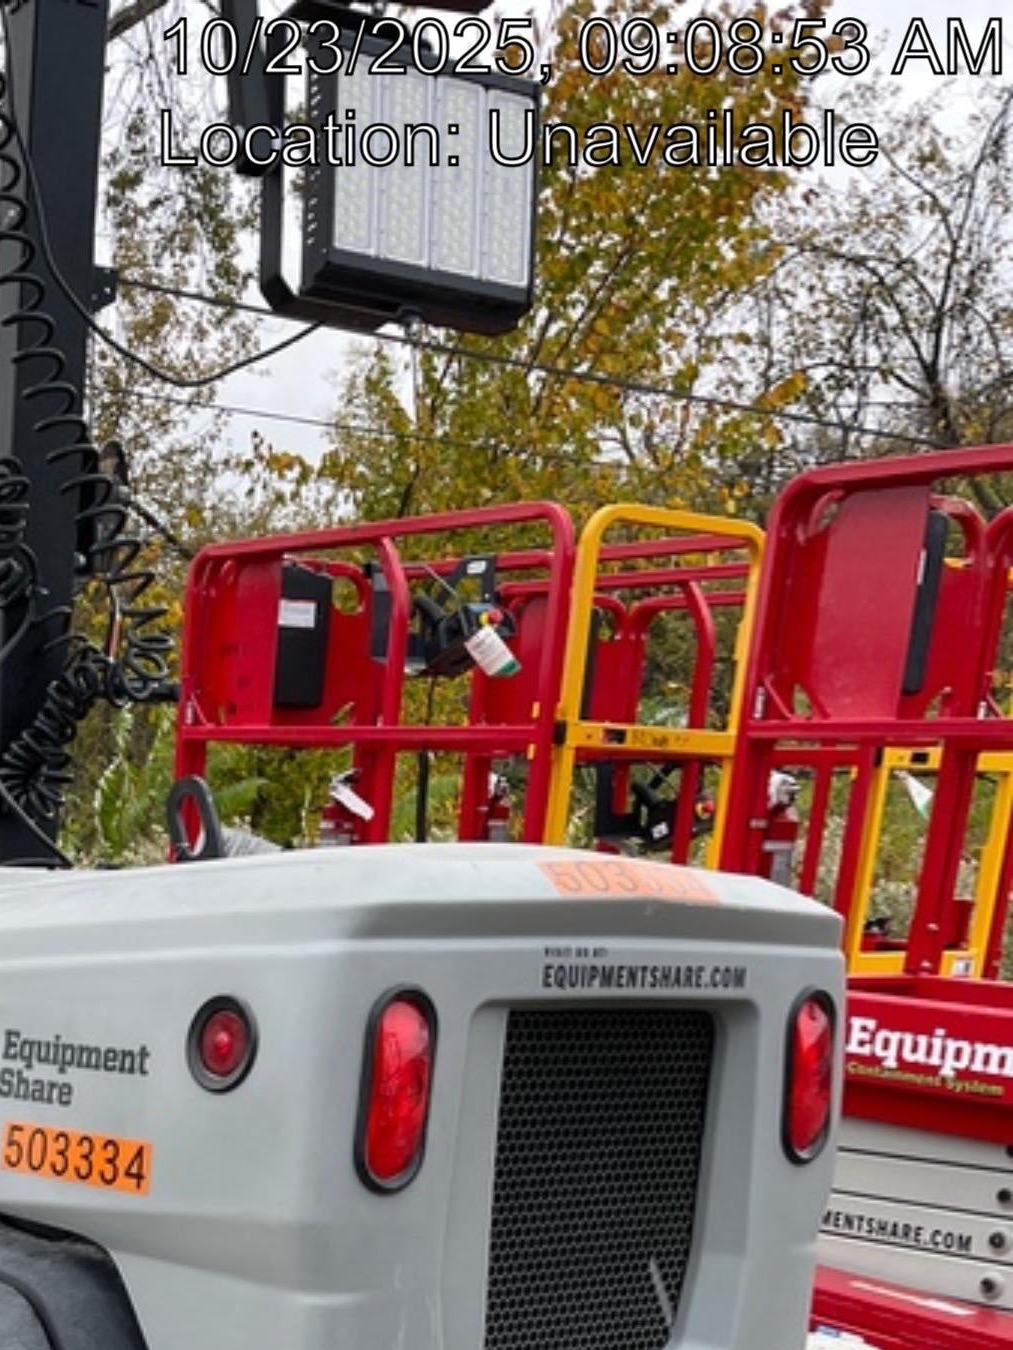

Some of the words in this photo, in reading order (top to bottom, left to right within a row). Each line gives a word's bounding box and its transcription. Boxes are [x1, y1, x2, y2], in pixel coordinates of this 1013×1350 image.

[542, 963, 747, 990] EQUIPMENTSHARE.COM
[1, 1029, 150, 1076] Equipment
[847, 1061, 942, 1086] Containment
[944, 1075, 1004, 1097] System
[4, 1123, 147, 1190] 503334
